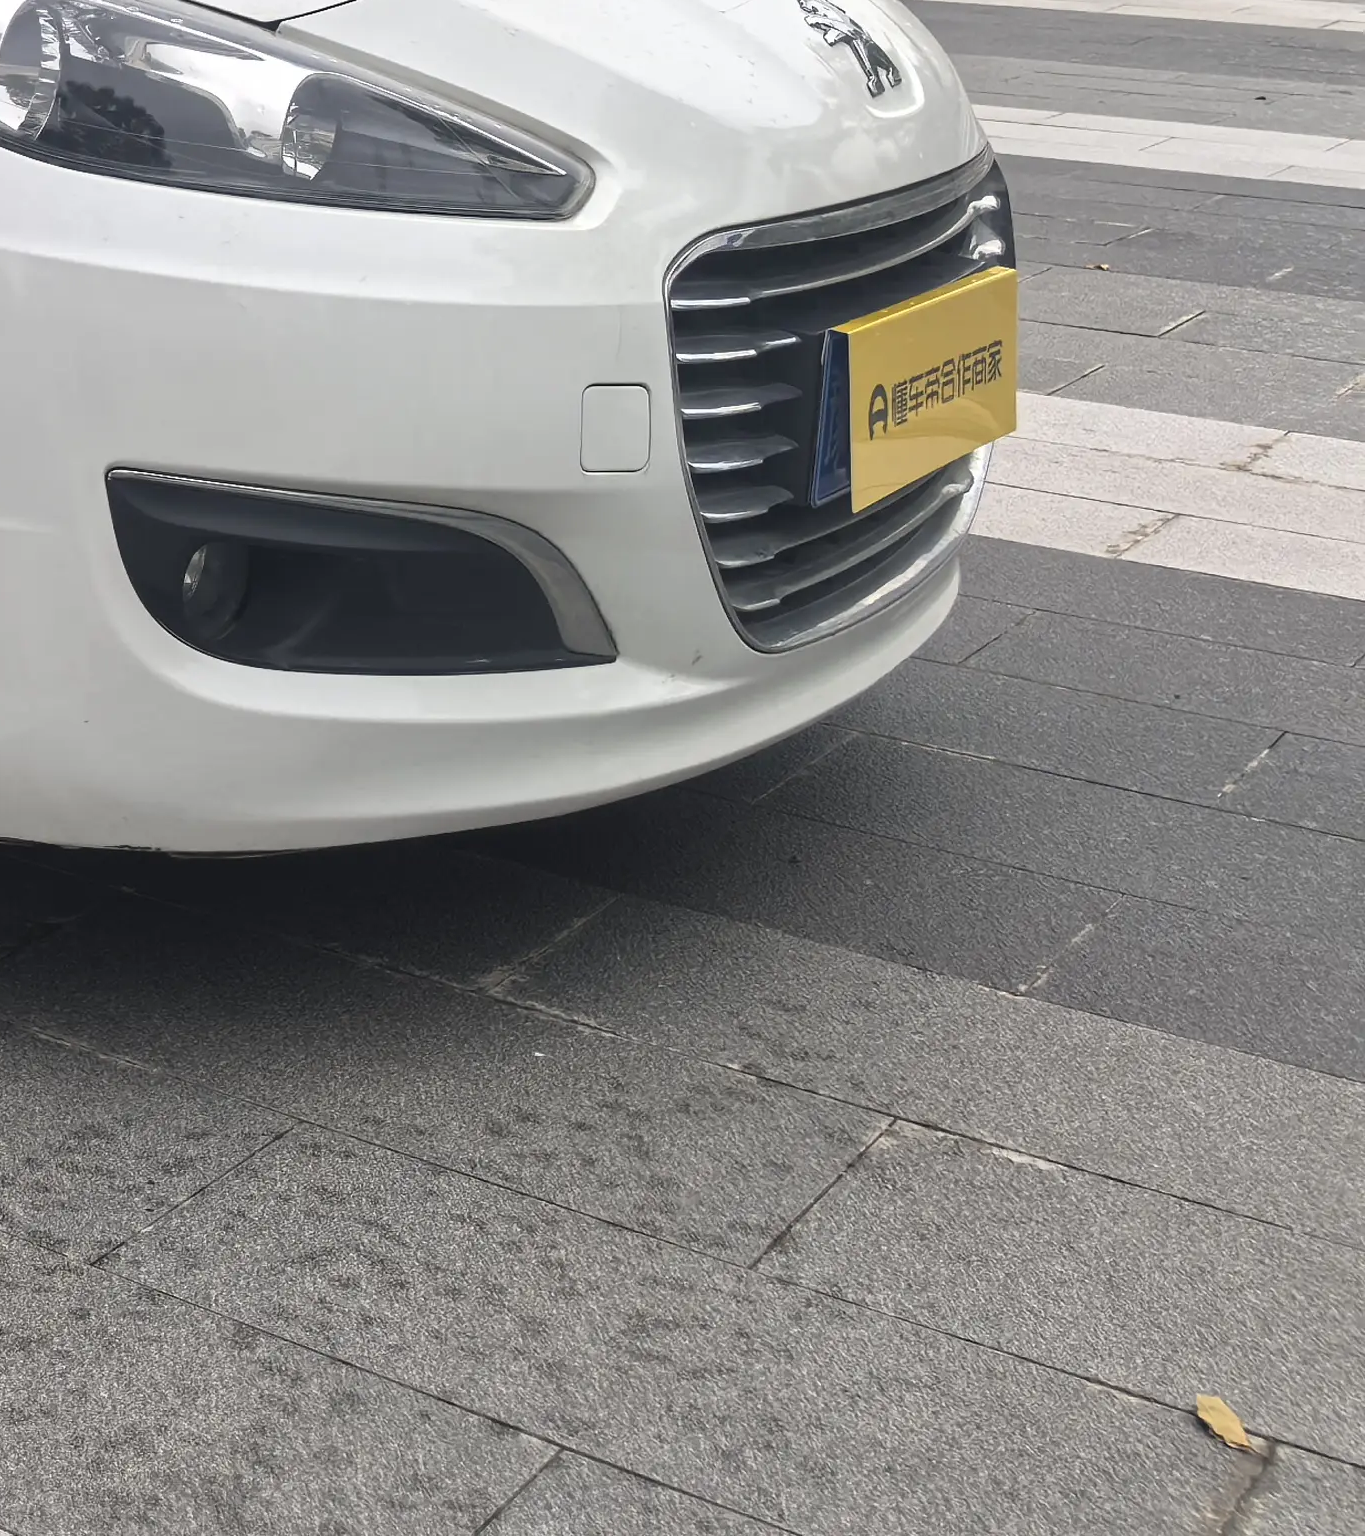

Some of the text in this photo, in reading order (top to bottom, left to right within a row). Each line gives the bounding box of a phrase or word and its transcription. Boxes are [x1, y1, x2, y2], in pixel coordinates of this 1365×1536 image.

[891, 340, 1002, 427] 懂车帝合作商家
